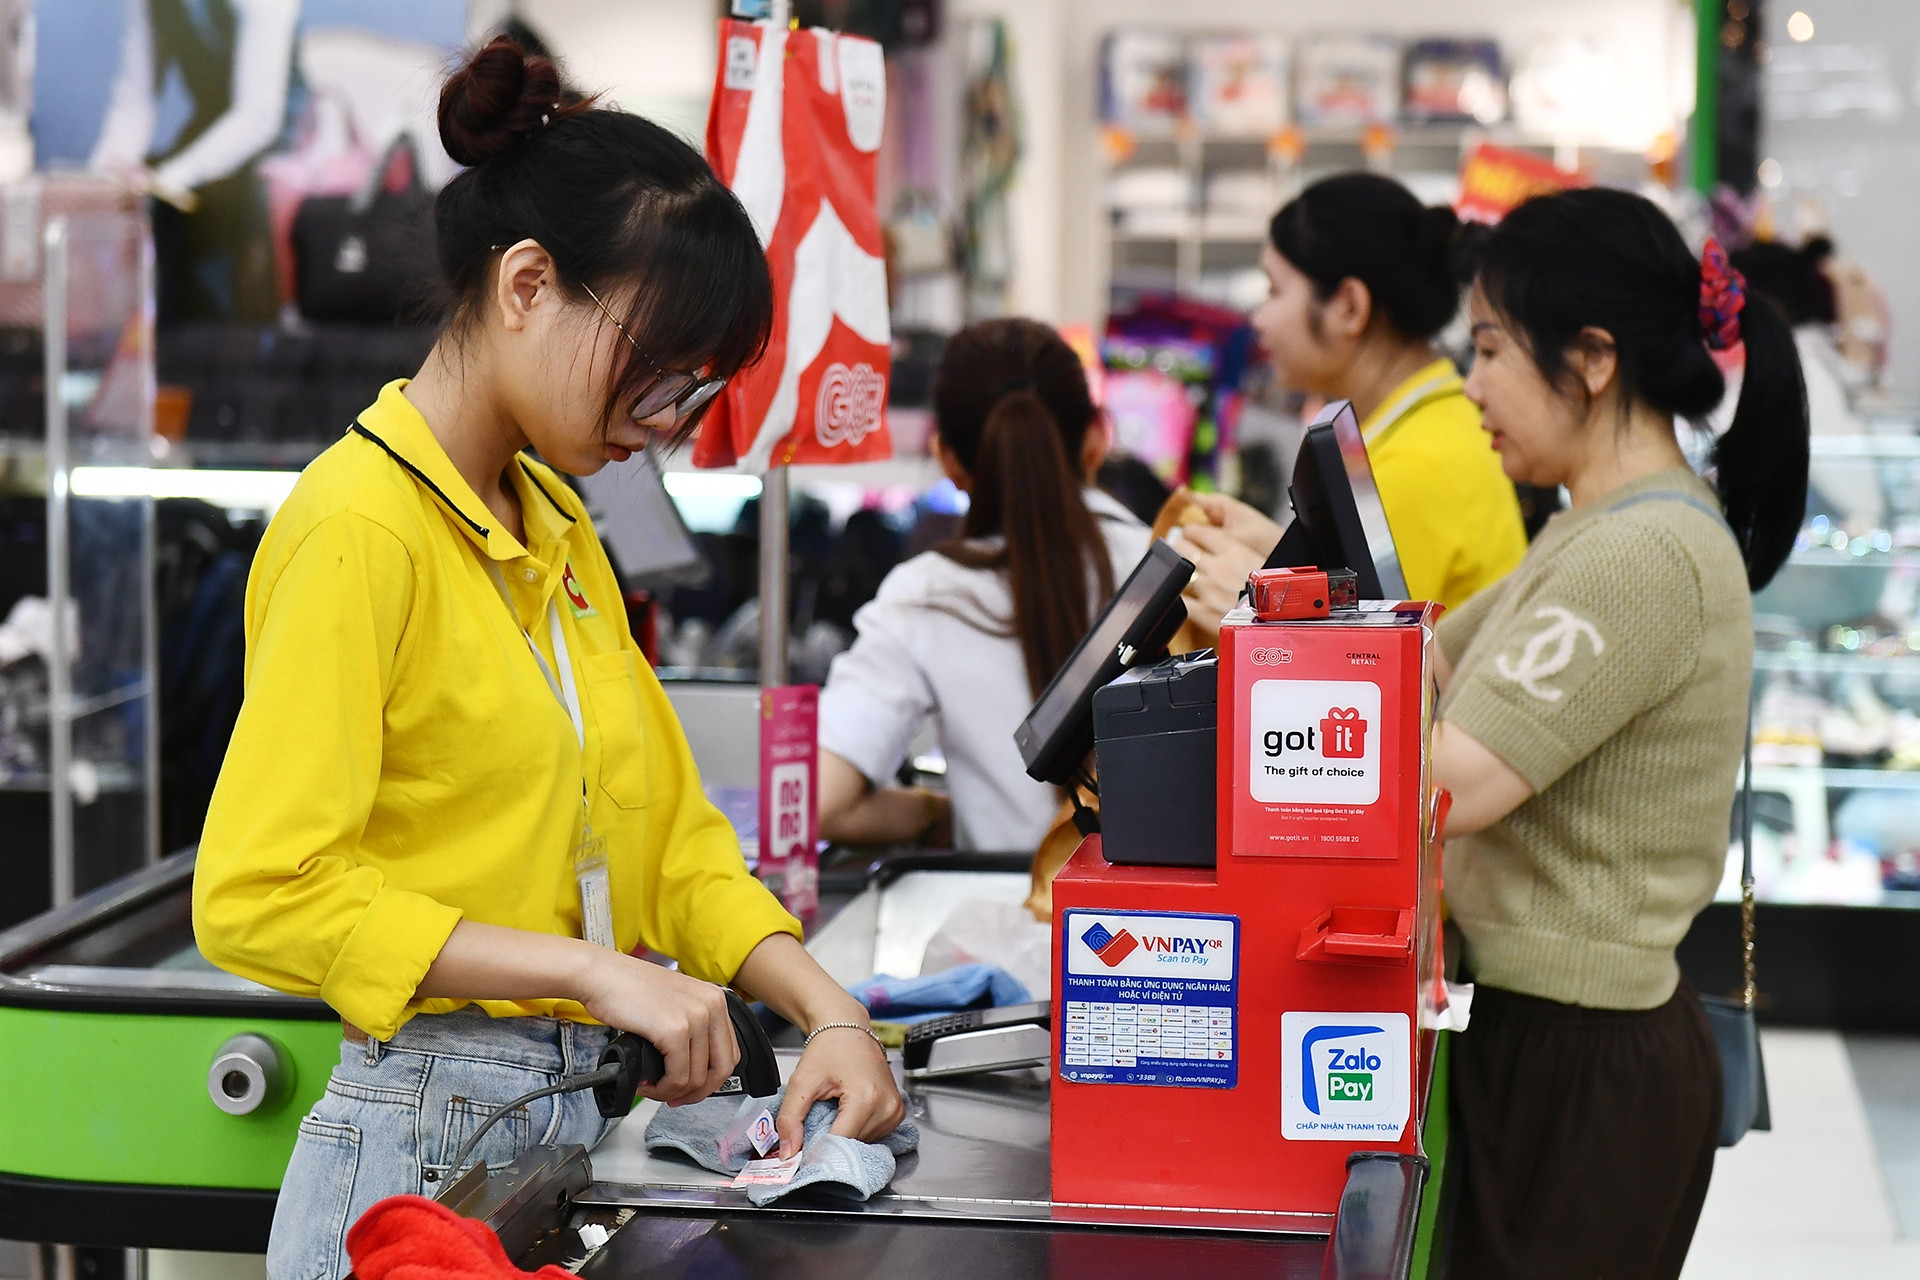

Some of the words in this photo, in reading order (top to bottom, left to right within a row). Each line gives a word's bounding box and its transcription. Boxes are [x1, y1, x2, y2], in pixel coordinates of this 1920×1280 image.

[1264, 726, 1315, 757] got
[1335, 725, 1353, 752] it
[1264, 765, 1286, 775] The
[1289, 766, 1309, 778] gift
[1312, 766, 1324, 776] of
[1327, 767, 1365, 777] choice
[1268, 834, 1309, 842] www.gotit.vn
[1157, 953, 1178, 963] Scan
[1181, 955, 1190, 963] to
[1192, 955, 1209, 966] Pay
[1068, 978, 1095, 987] THANH
[1097, 977, 1119, 988] TOÁN
[1120, 977, 1142, 989] BẰNG
[1144, 979, 1161, 990] ỨNG
[1162, 981, 1184, 992] DỤNG
[1185, 980, 1208, 991] NGÂN
[1209, 981, 1231, 992] HÀNG
[1118, 990, 1140, 1001] HOẶC
[1142, 990, 1150, 999] VÍ
[1151, 991, 1169, 1002] ĐIỆN
[1171, 990, 1184, 1000] TỬ
[1328, 1047, 1381, 1071] Zalo
[1330, 1077, 1372, 1101] Pay
[1296, 1120, 1319, 1130] CHẤP
[1320, 1122, 1344, 1132] NHẬN
[1377, 1121, 1399, 1131] TOÁN
